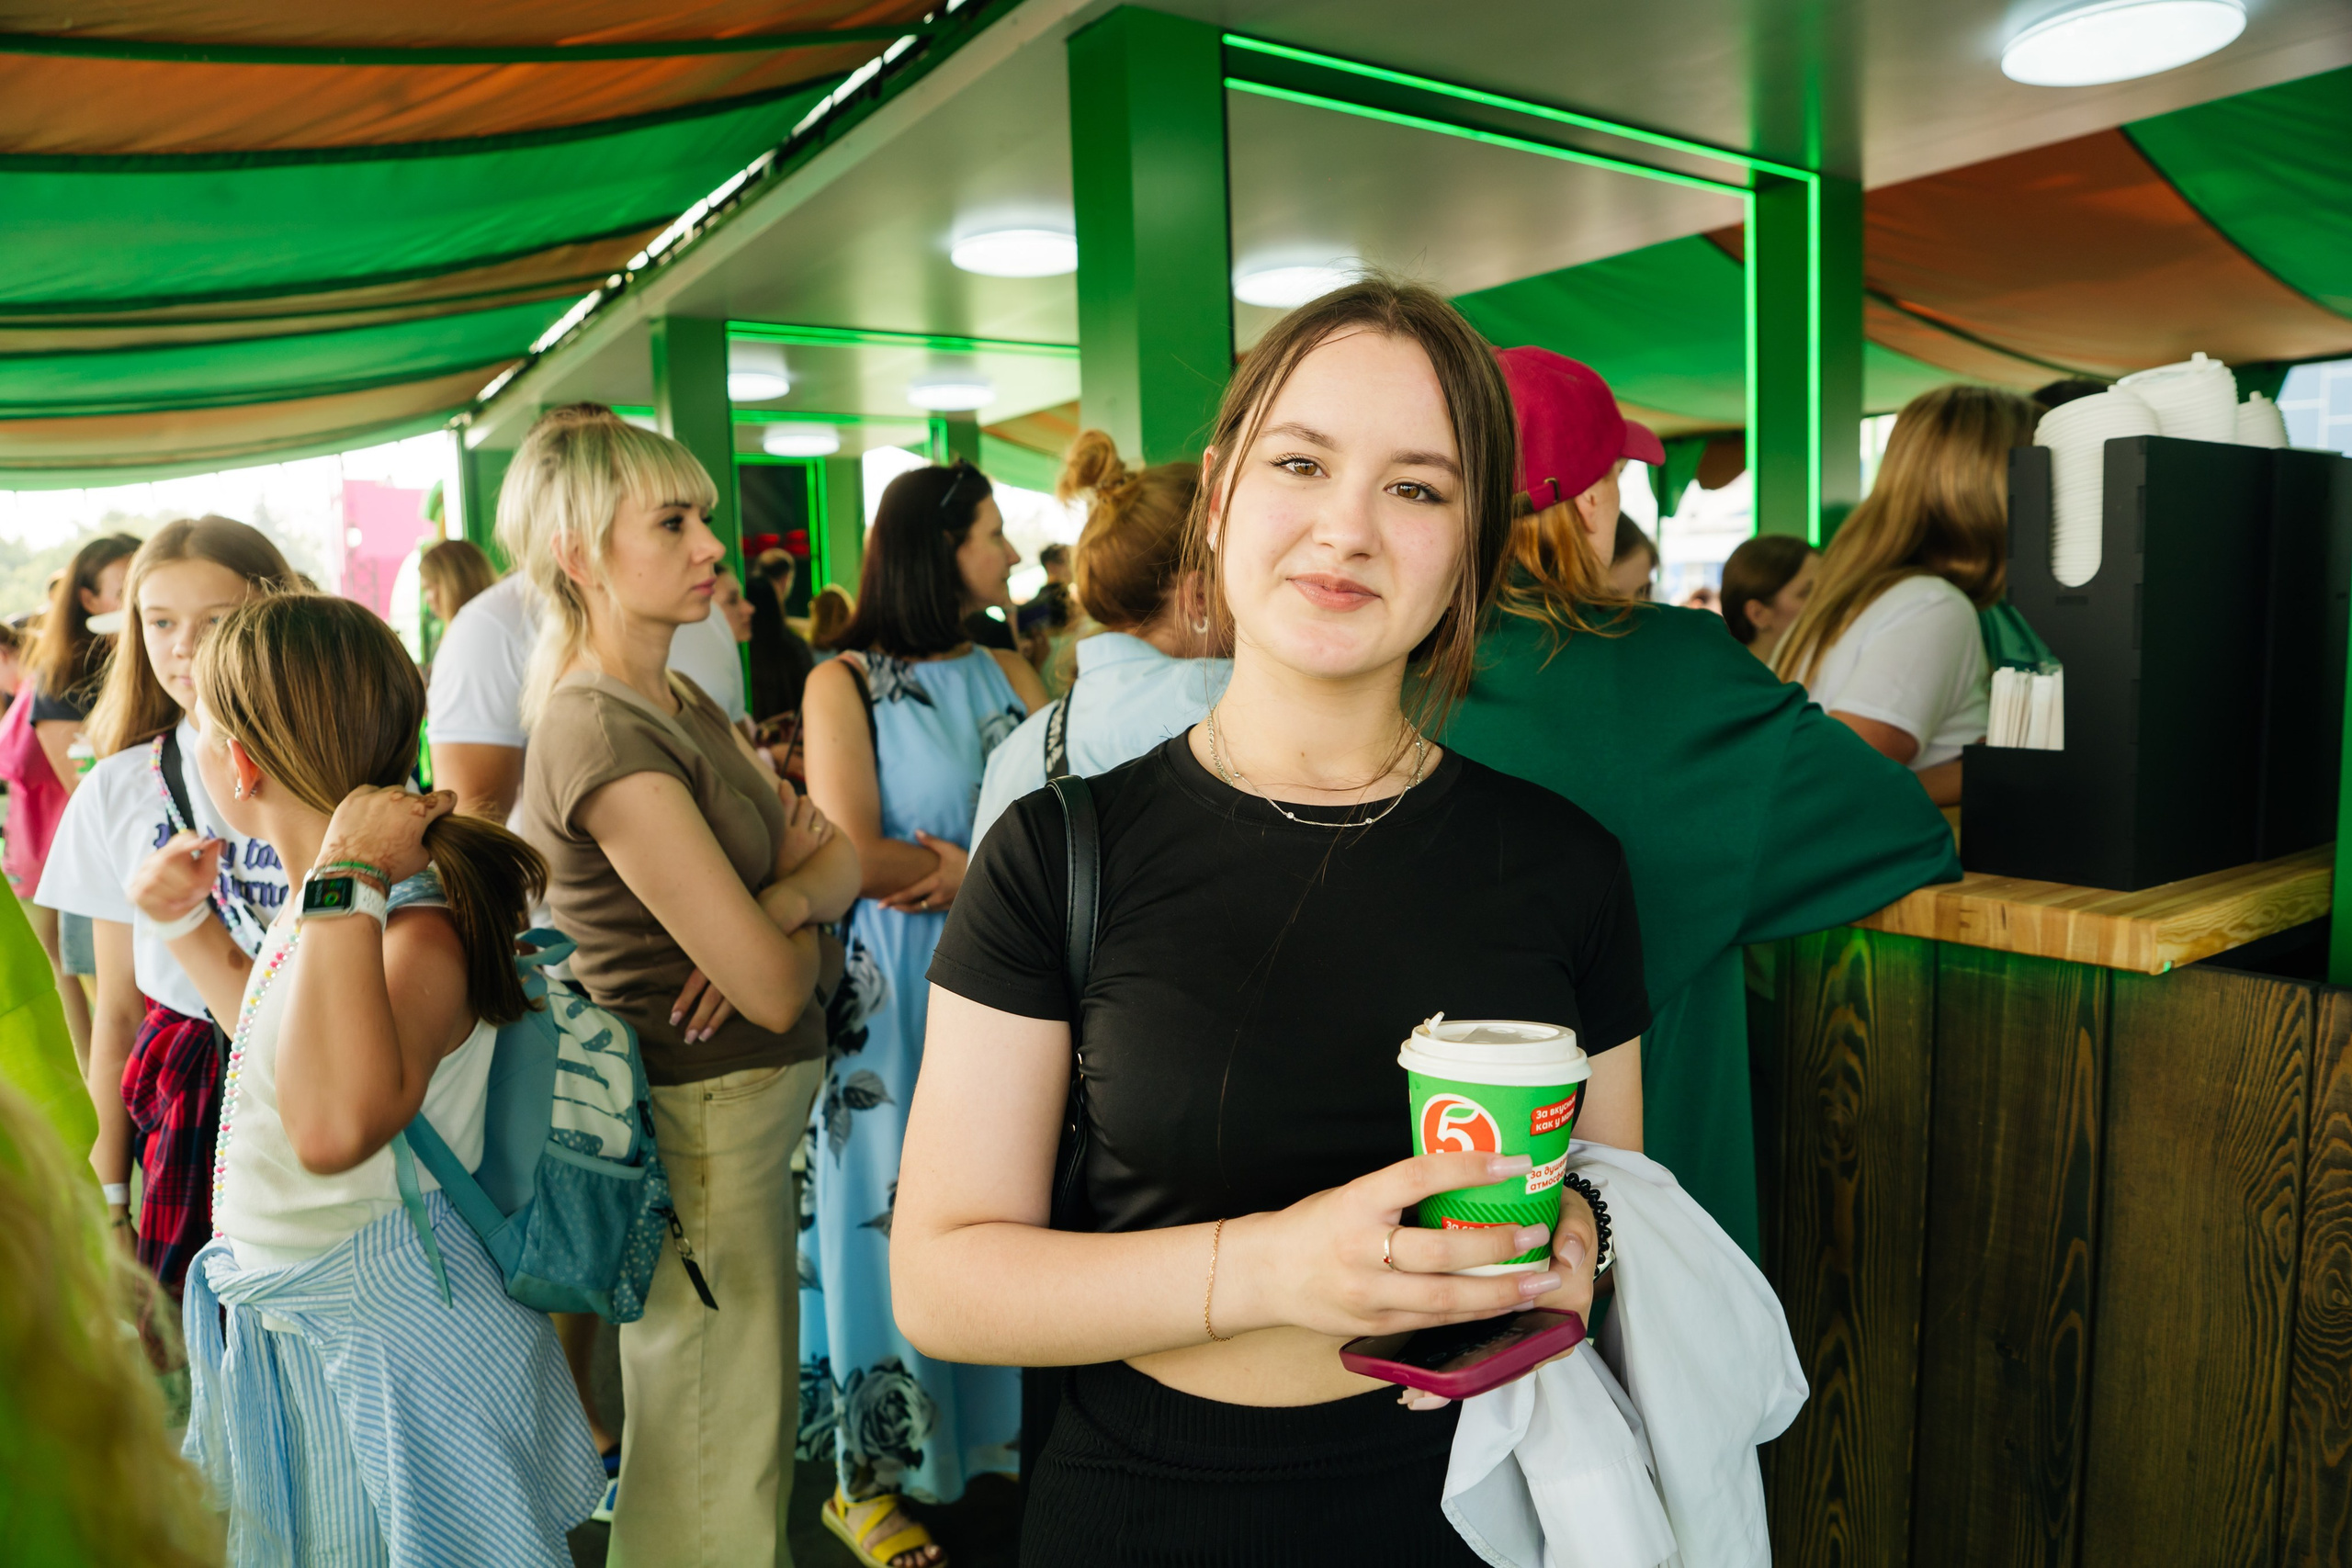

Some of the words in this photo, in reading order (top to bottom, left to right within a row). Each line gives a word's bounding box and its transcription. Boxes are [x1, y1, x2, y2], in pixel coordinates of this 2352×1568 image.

[1536, 1110, 1548, 1120] За
[1436, 1102, 1480, 1153] 5
[1536, 1121, 1553, 1132] как
[1555, 1118, 1561, 1128] у
[1530, 1170, 1542, 1179] За
